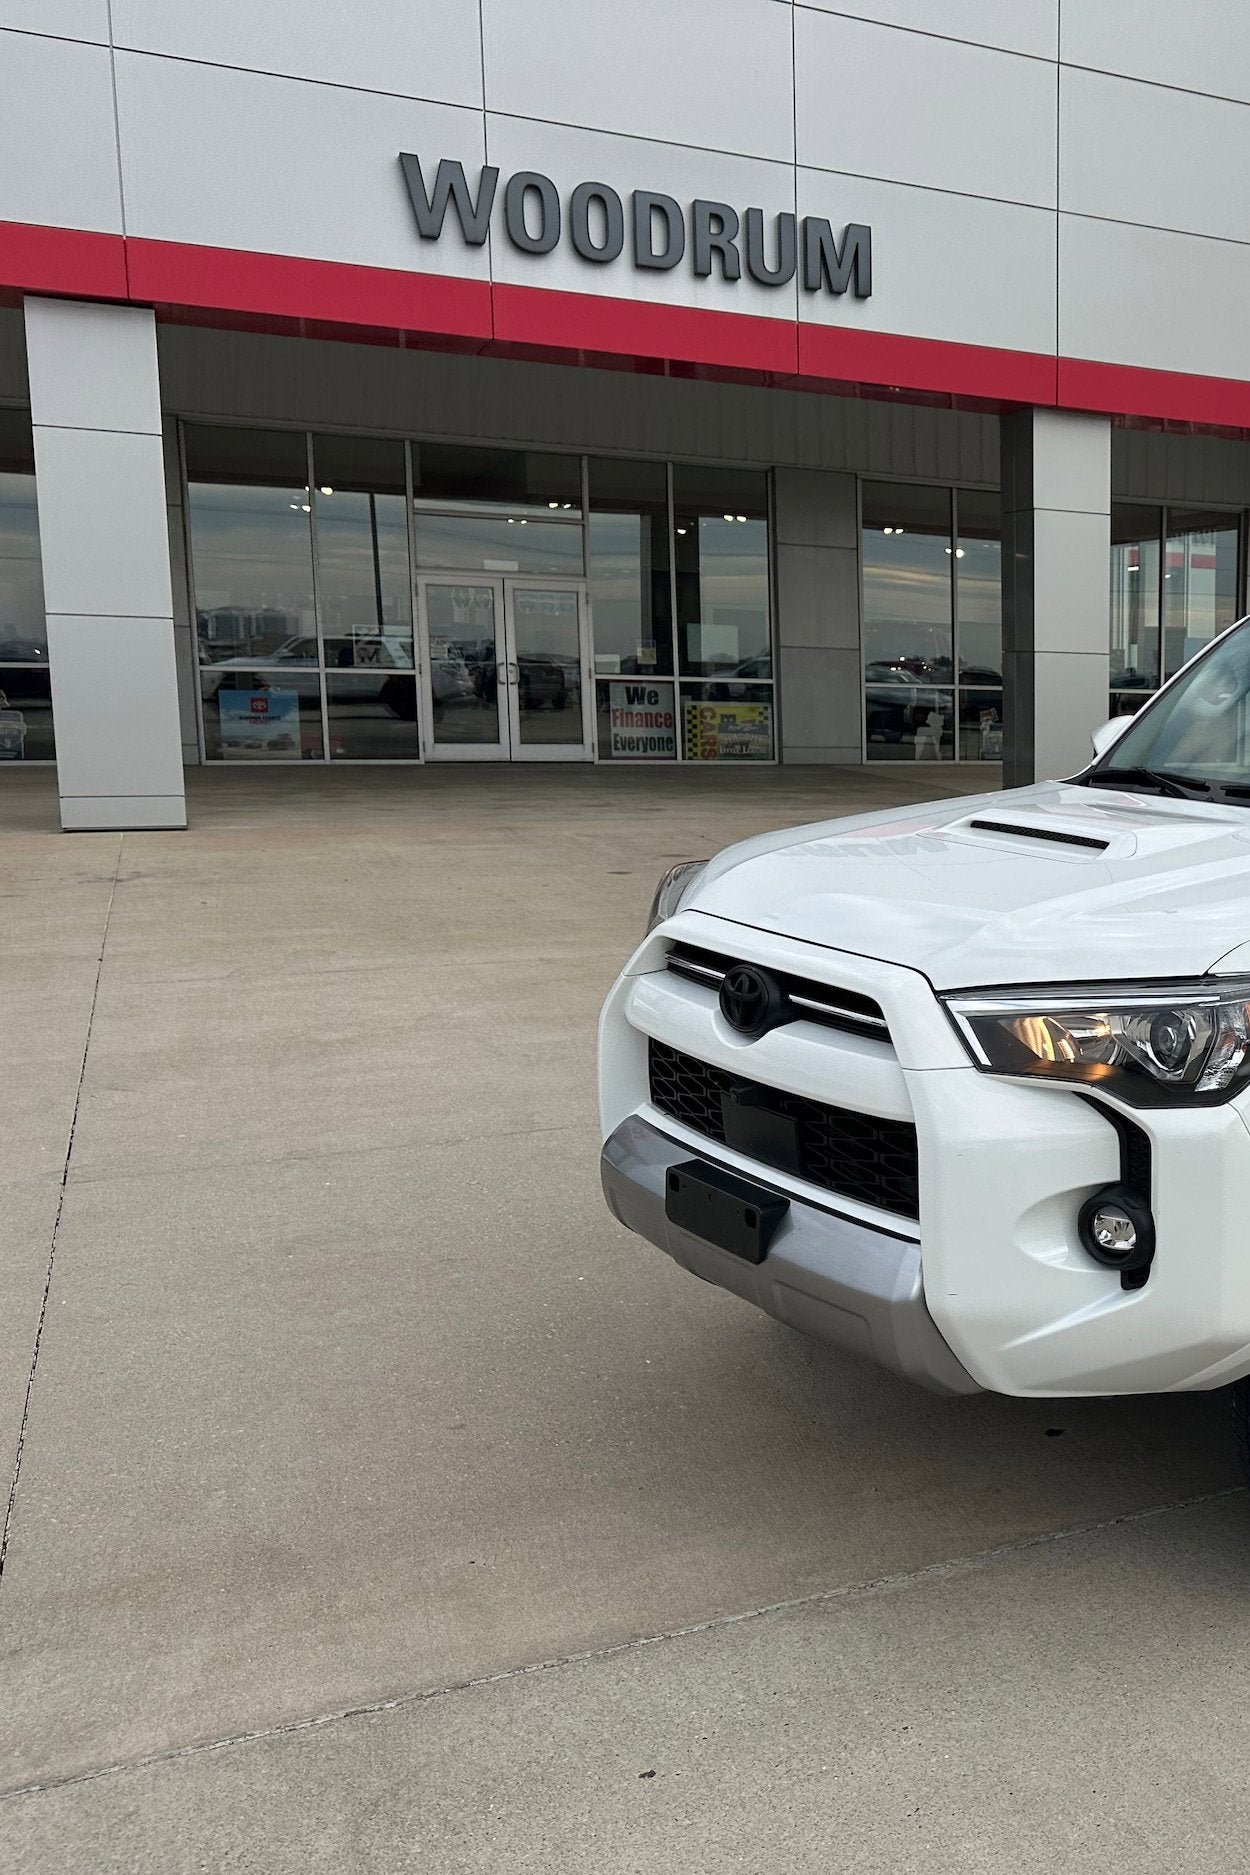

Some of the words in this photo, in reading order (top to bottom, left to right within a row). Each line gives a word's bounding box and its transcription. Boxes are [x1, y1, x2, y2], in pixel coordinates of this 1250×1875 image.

[399, 152, 872, 298] WOODRUM
[625, 686, 659, 706] We
[611, 708, 673, 728] Finance
[700, 706, 718, 759] CARS
[613, 733, 674, 753] Everyone
